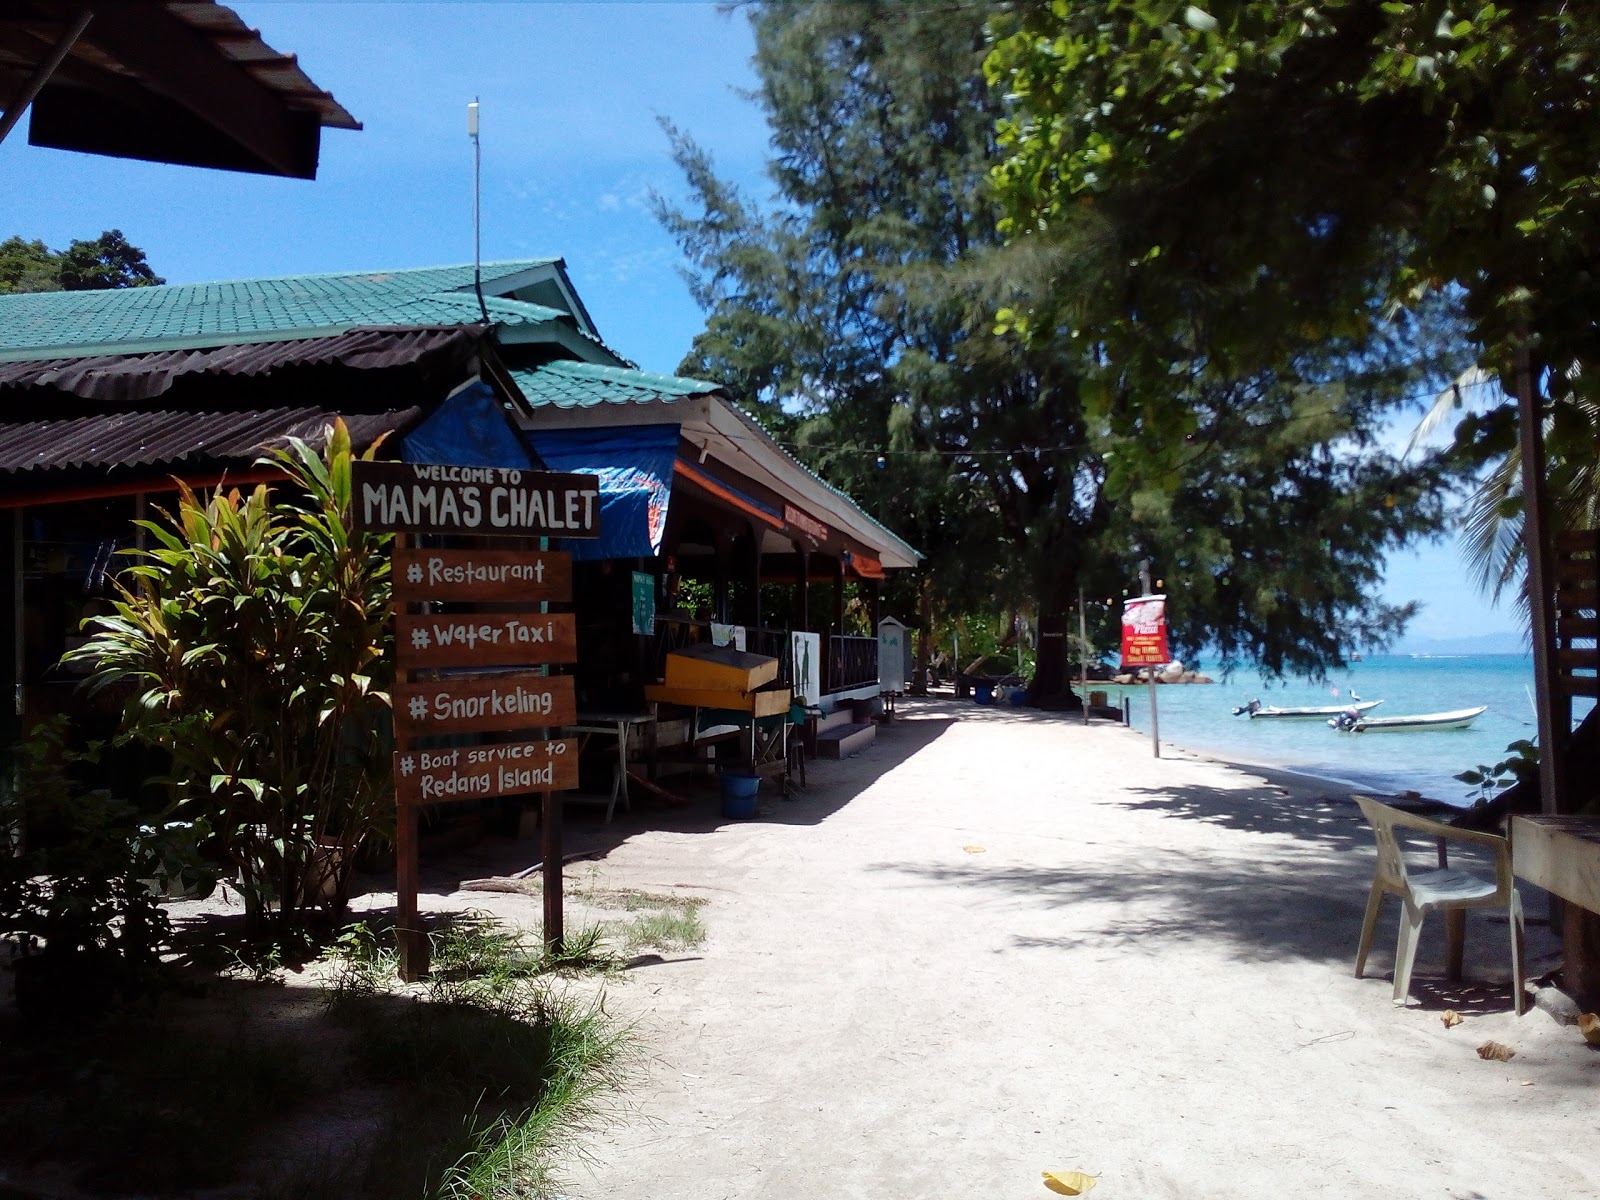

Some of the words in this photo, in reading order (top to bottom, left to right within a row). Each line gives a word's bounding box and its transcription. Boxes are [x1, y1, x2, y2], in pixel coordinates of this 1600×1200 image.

[413, 464, 493, 485] WELCOME
[498, 468, 522, 485] TO
[363, 482, 482, 528] MAMA'S
[490, 487, 598, 530] CHALET
[506, 621, 553, 644] Taxi
[468, 744, 534, 763] service
[545, 741, 566, 757] to
[420, 770, 490, 800] Redang
[497, 761, 553, 792] Island
